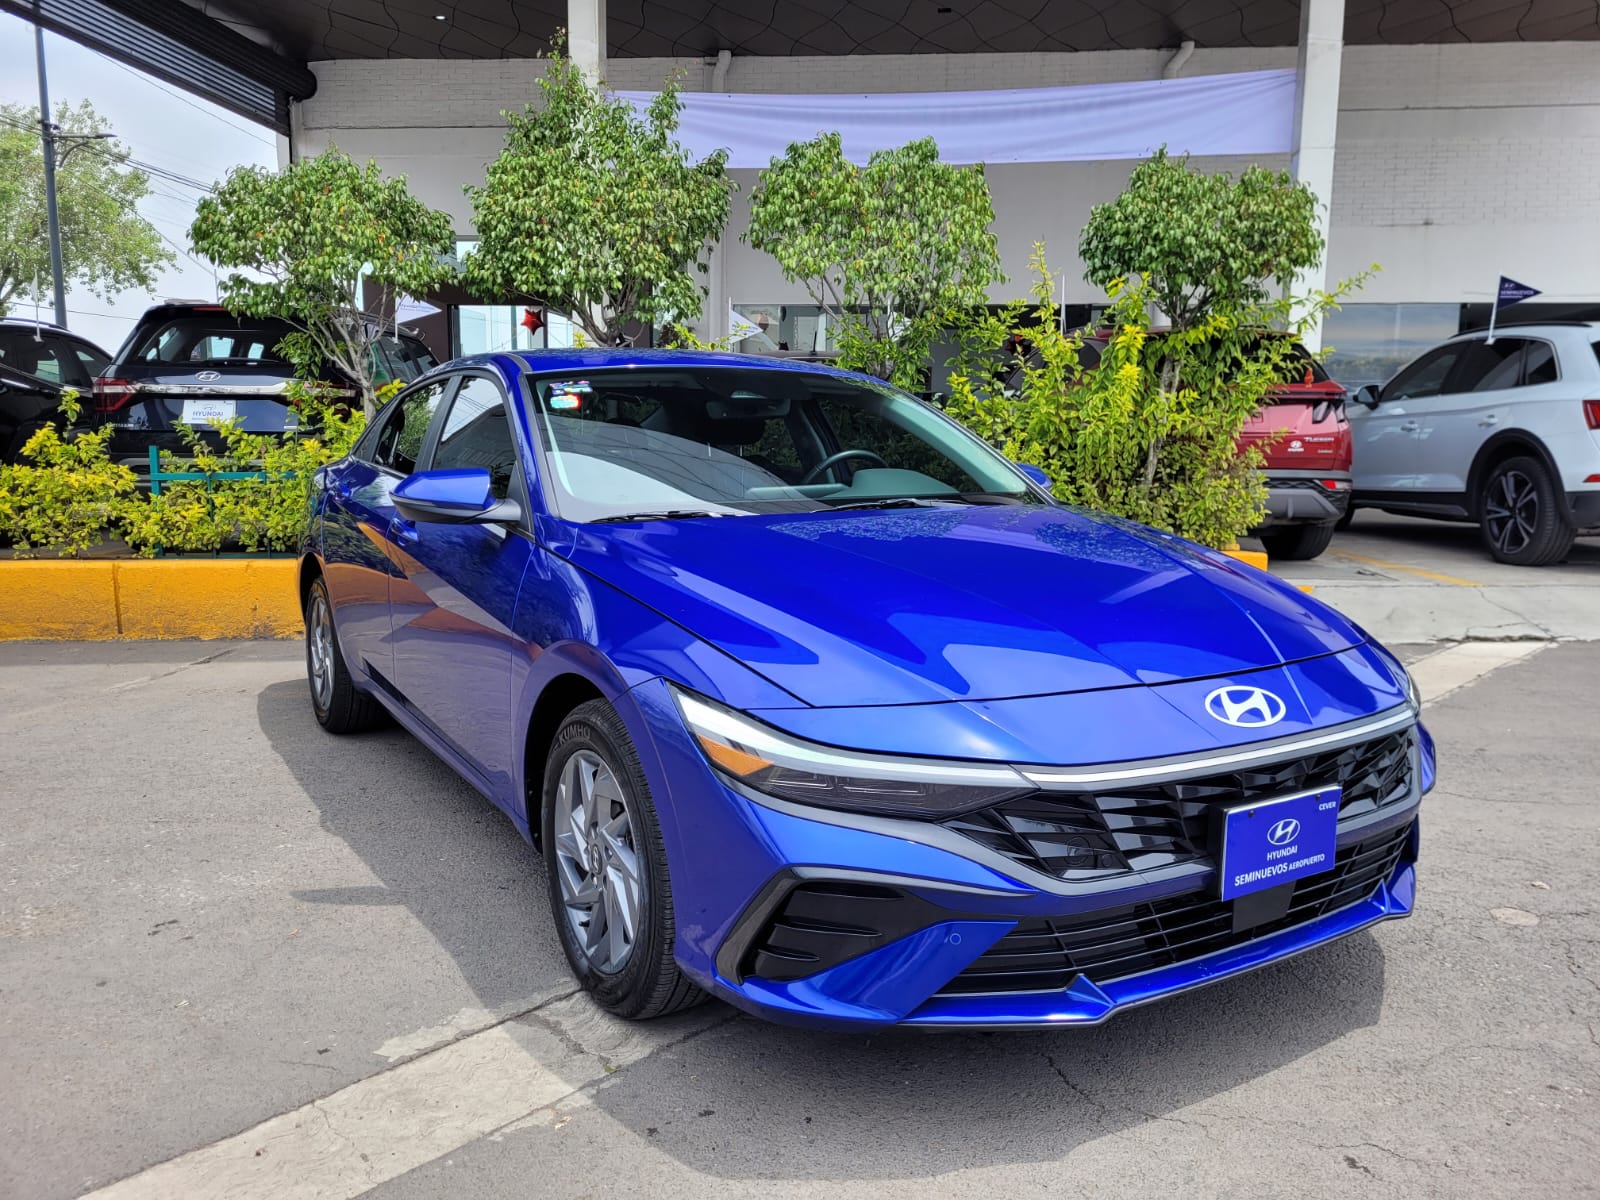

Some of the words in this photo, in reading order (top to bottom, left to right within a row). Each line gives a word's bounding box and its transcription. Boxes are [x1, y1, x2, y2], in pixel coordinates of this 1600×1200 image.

[558, 724, 591, 744] KUMHO
[1318, 801, 1337, 811] CEVER
[1266, 845, 1298, 861] HYUNDAI
[1234, 862, 1288, 887] SEMINUEVOS
[1288, 853, 1326, 871] AEROPUERTO
